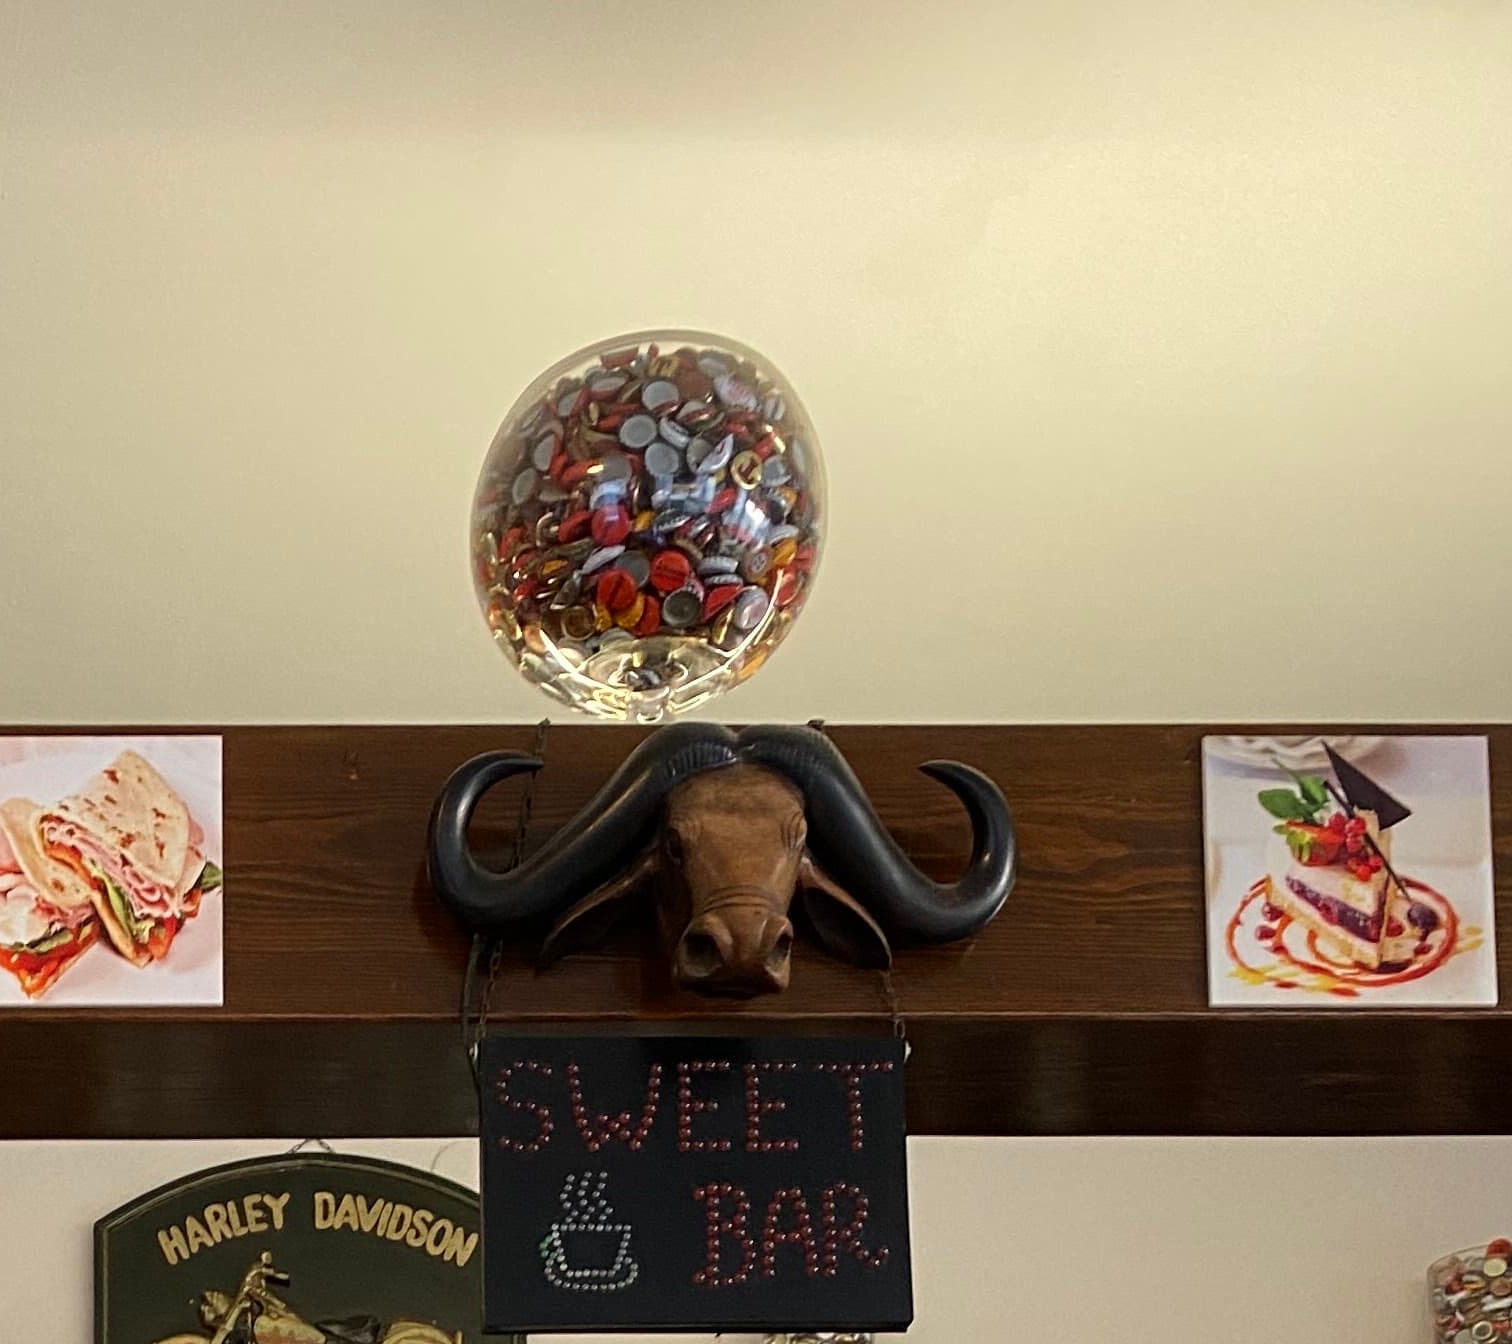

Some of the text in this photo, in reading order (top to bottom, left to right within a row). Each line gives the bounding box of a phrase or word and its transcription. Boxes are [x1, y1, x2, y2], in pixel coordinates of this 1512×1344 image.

[496, 1060, 894, 1153] SWEET
[157, 1191, 479, 1267] HARLEY DAVIDSON
[691, 1181, 889, 1287] BAR
